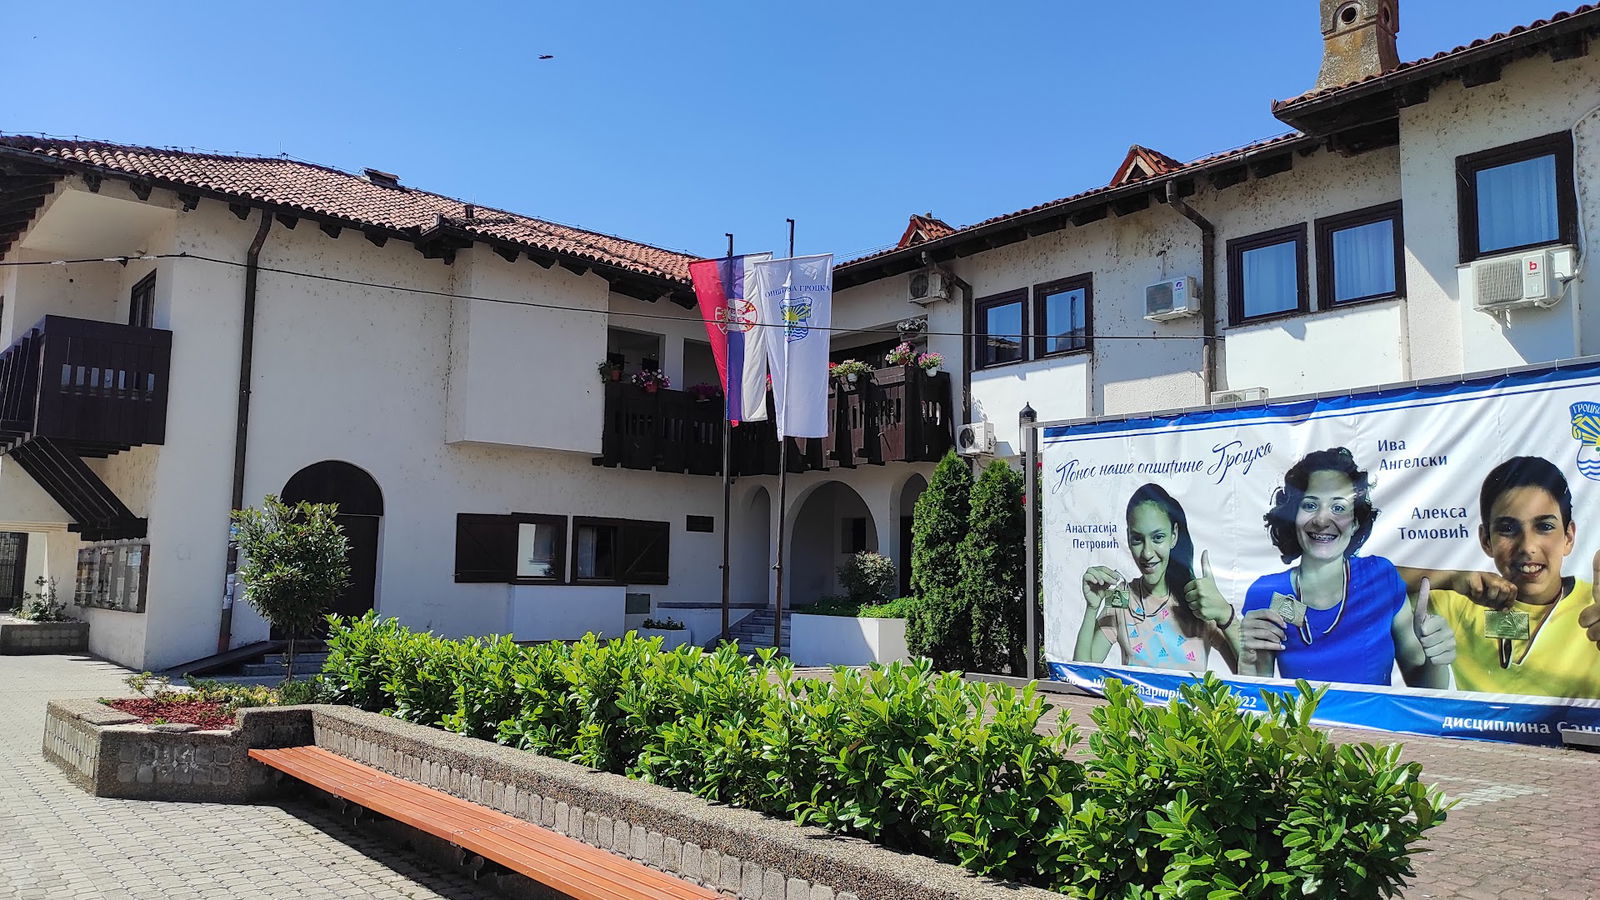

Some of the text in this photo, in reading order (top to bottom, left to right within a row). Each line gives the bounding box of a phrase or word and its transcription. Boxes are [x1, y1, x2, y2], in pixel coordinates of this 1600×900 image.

[1378, 439, 1406, 452] Ива
[1052, 440, 1273, 494] Понос наше општине Гроцка
[1379, 455, 1448, 471] Ангелски
[1411, 506, 1467, 519] Алекса
[1065, 523, 1117, 538] Анастасија
[1398, 524, 1469, 540] Томовић
[1072, 537, 1120, 552] Петровић
[1442, 716, 1551, 734] дисциплина
